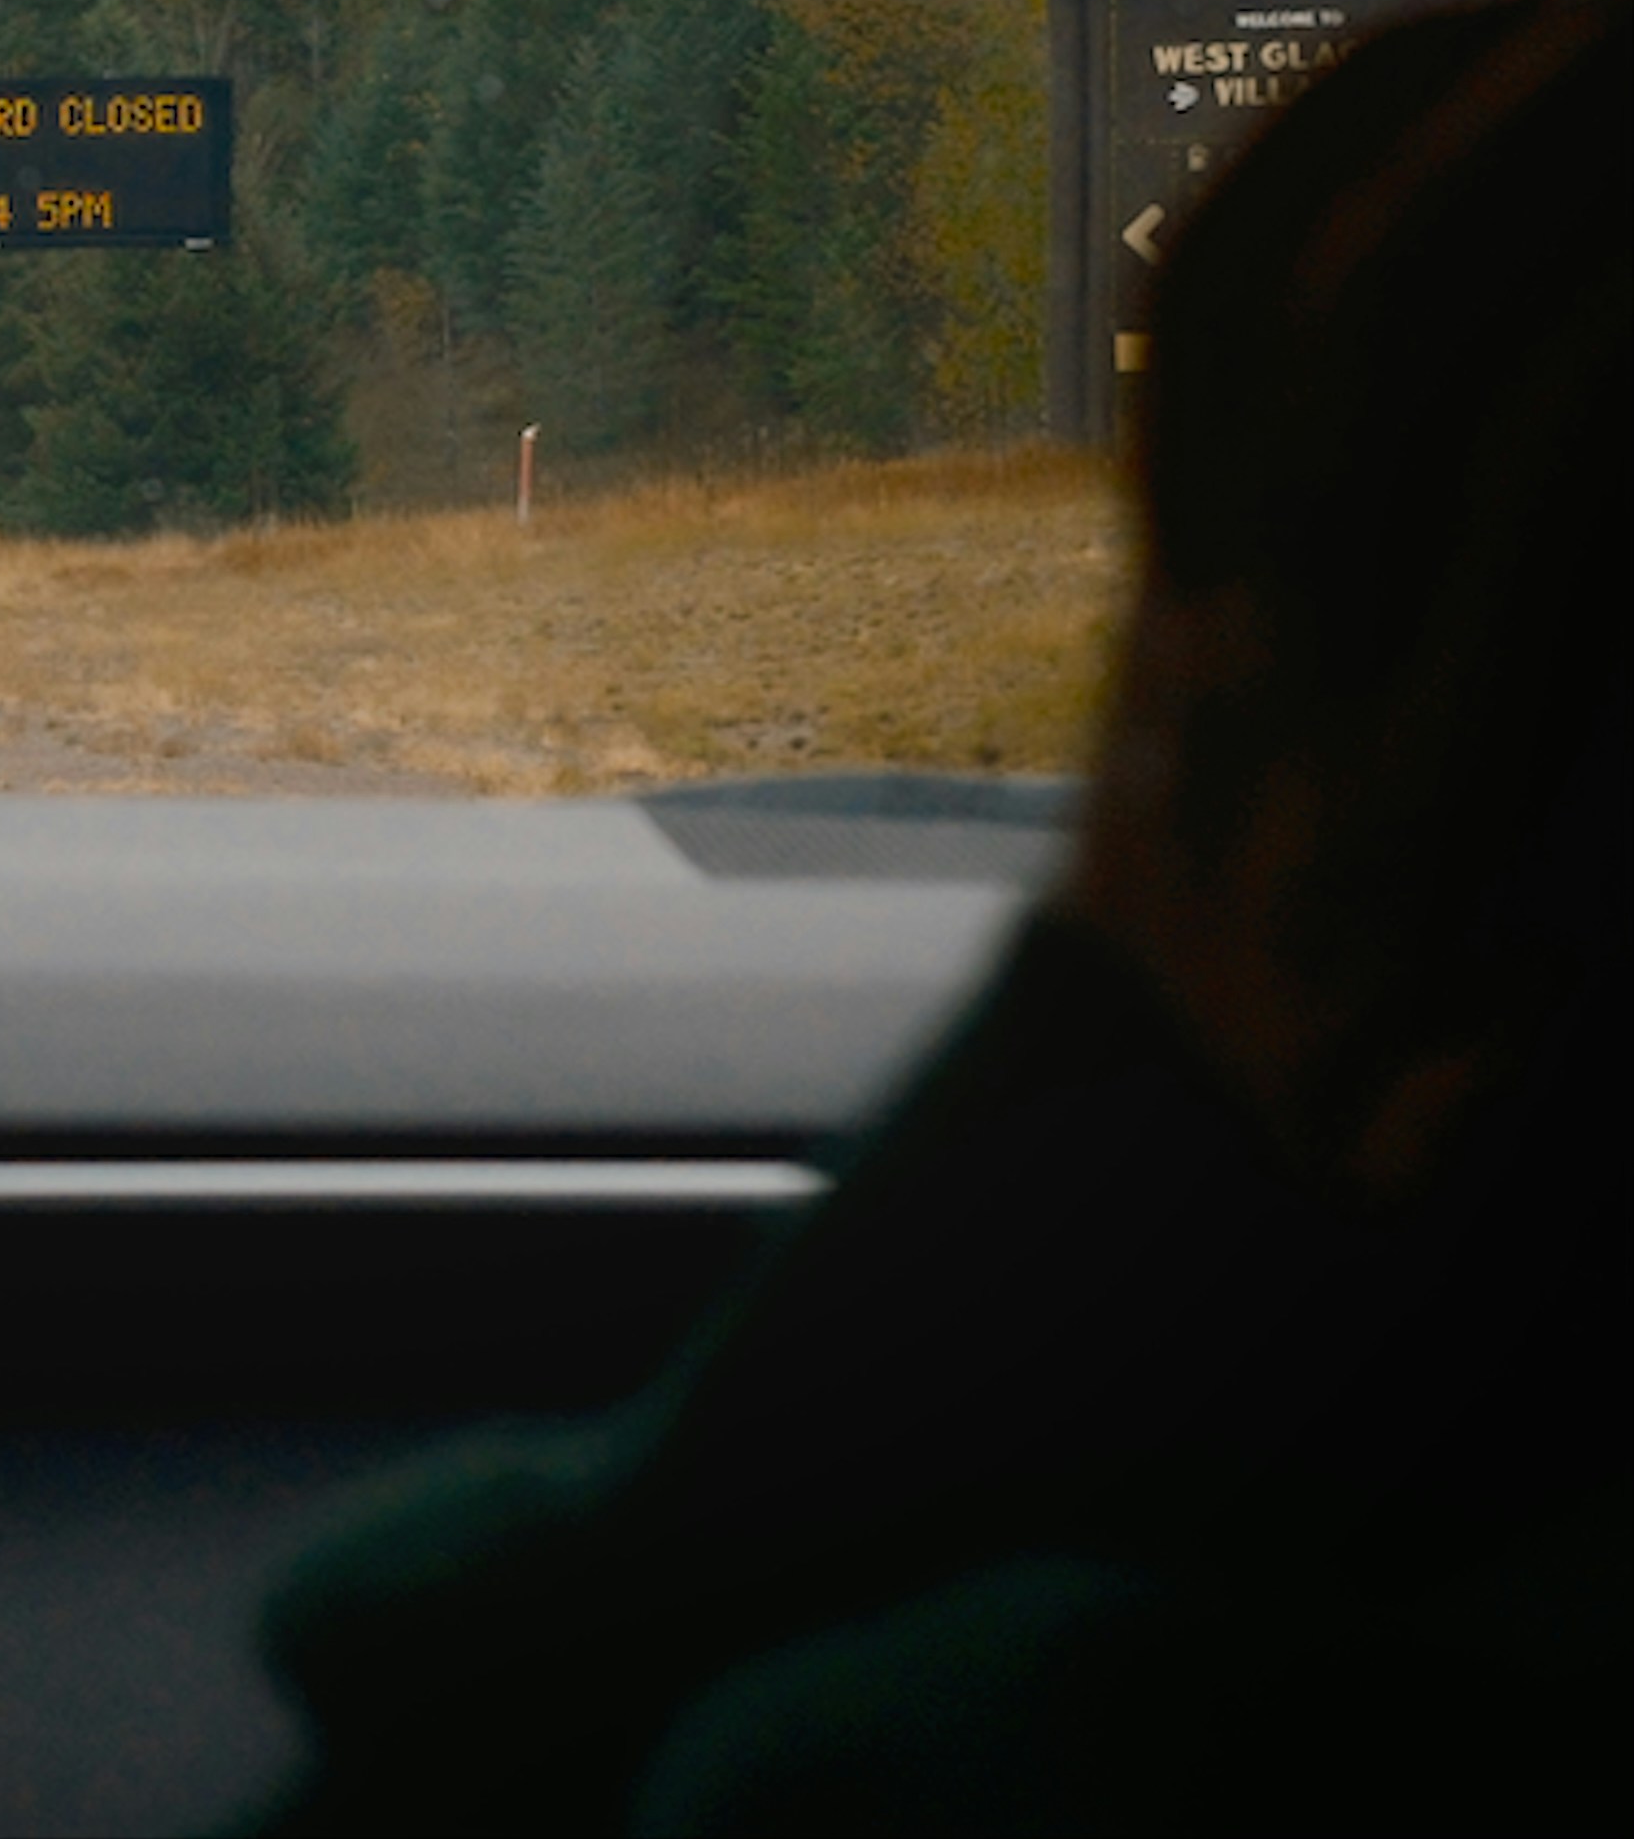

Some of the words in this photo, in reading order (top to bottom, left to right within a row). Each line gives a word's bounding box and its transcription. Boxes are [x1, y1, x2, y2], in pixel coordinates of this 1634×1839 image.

[1234, 10, 1317, 29] WELCOME
[1318, 9, 1347, 27] TO
[1152, 41, 1249, 75] WEST
[58, 95, 204, 135] CLOSED
[36, 190, 114, 231] 5PM
